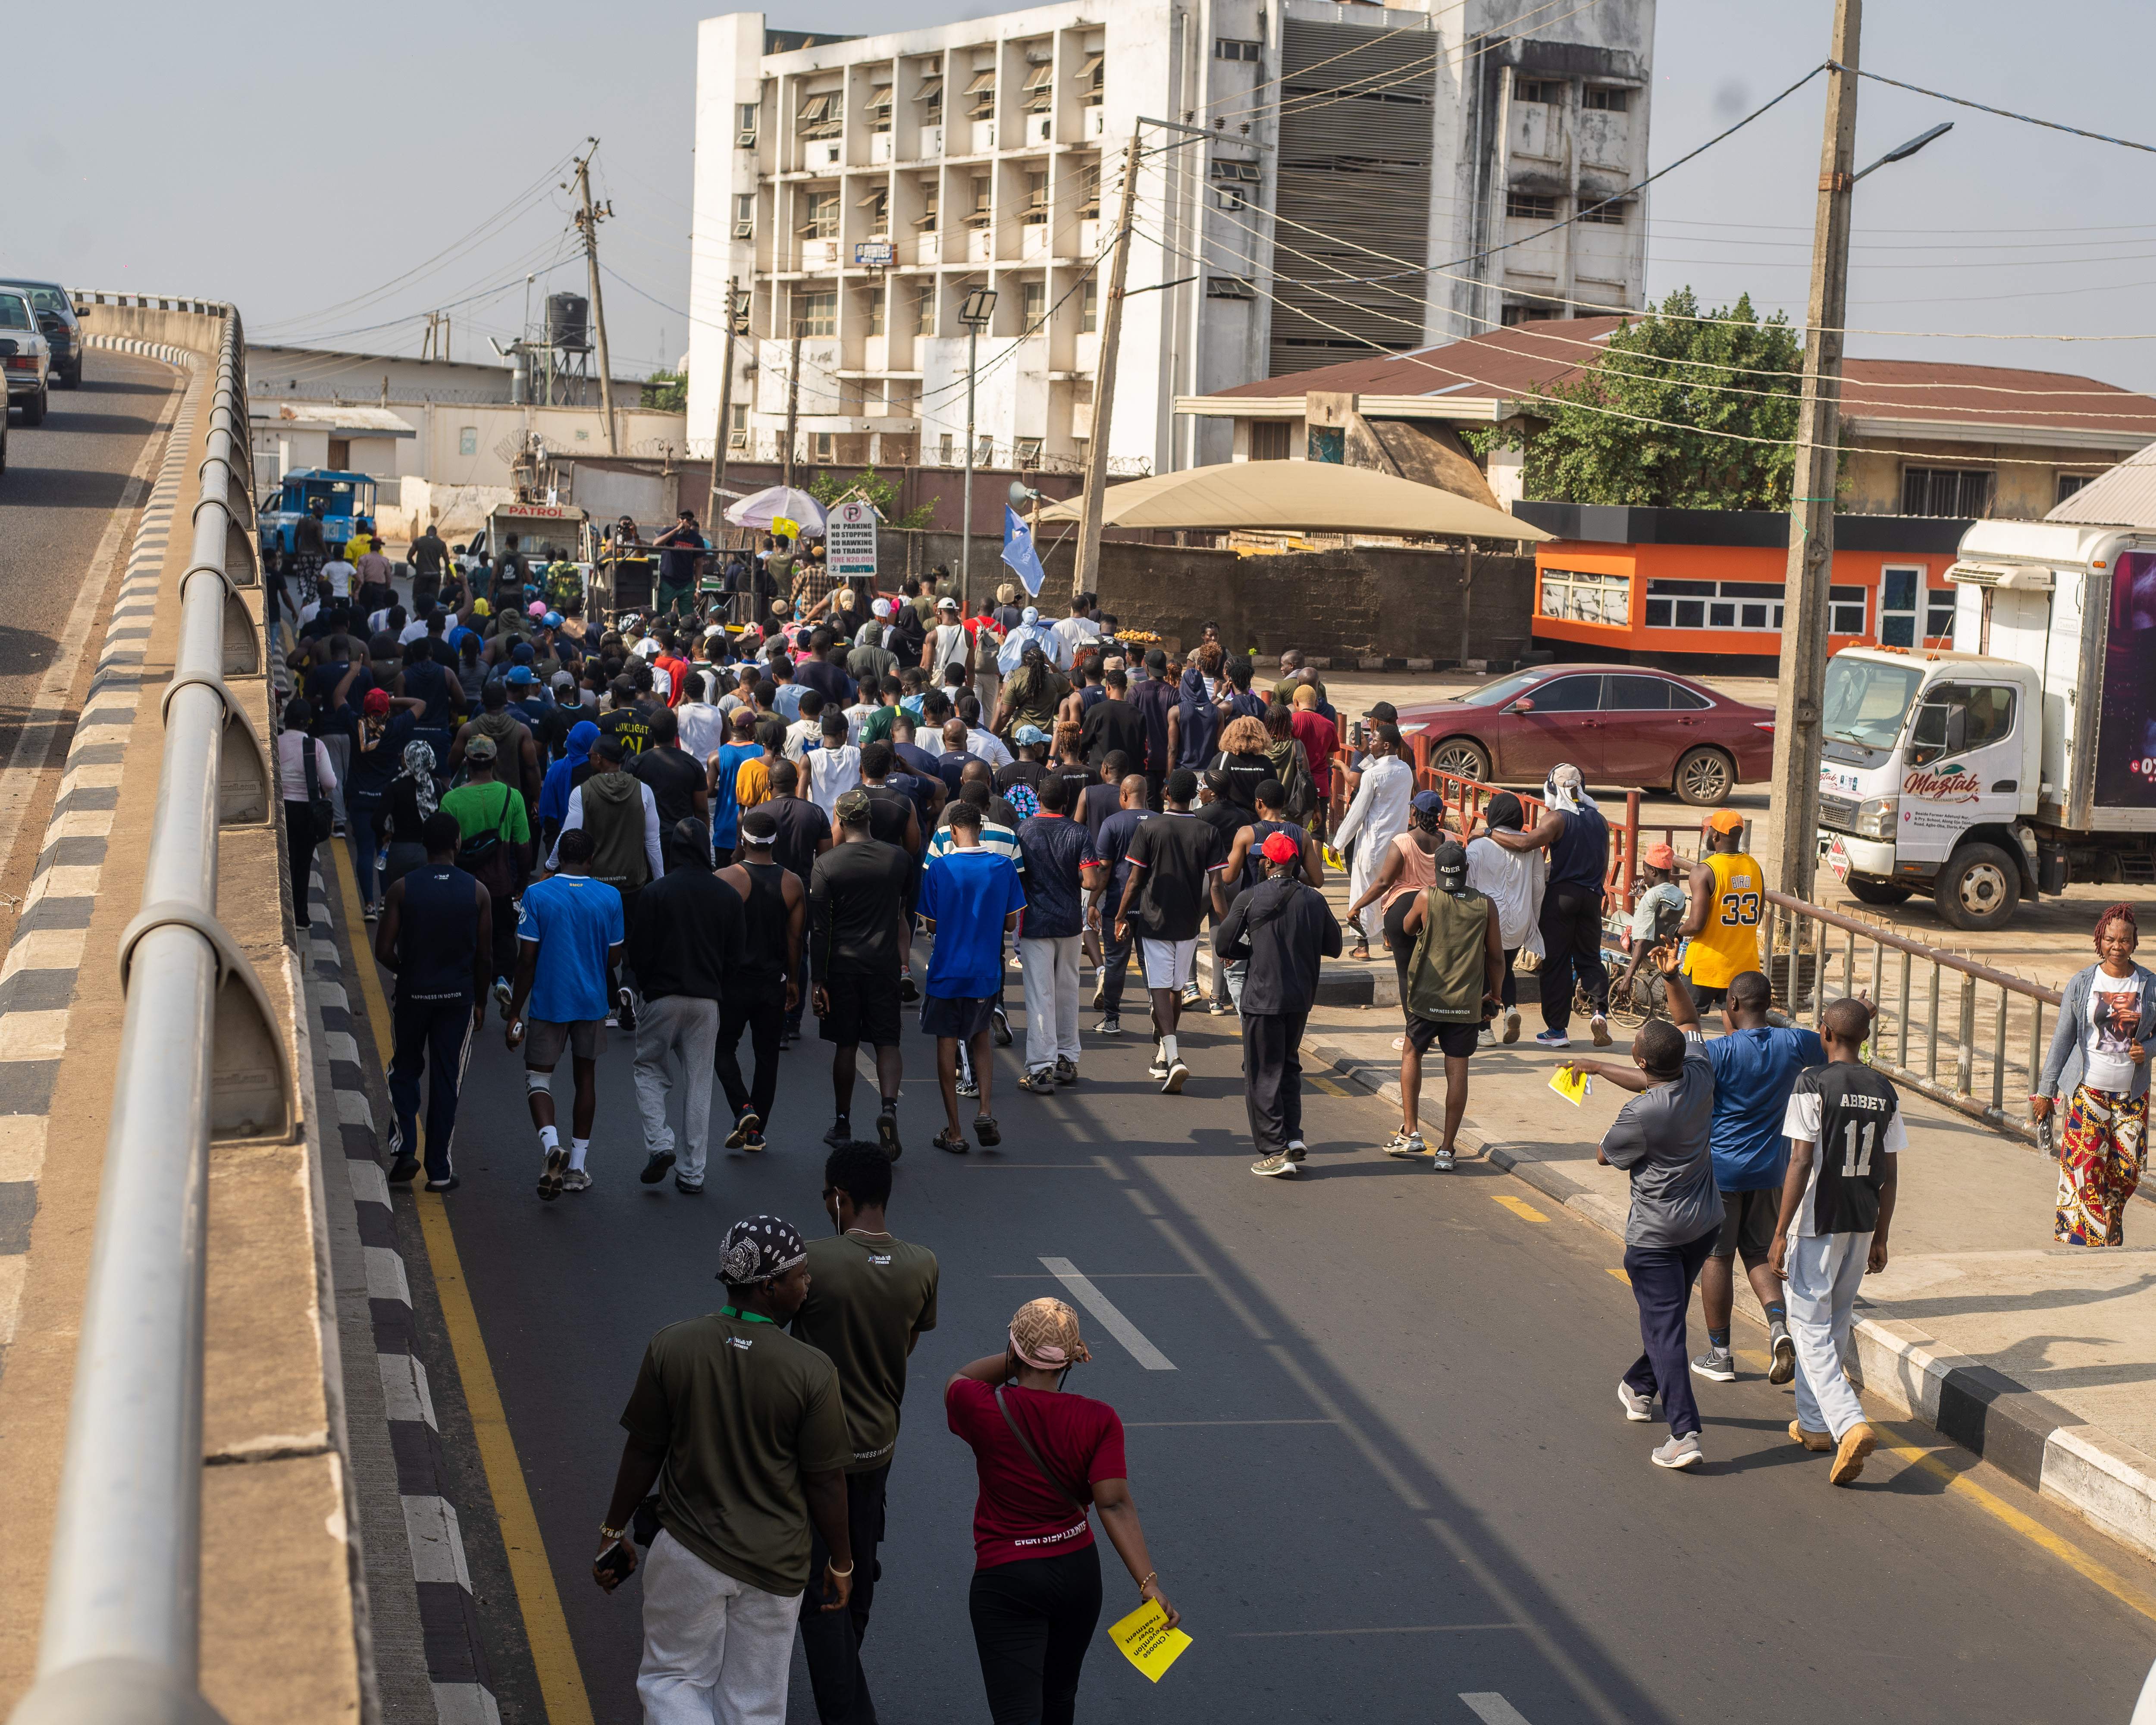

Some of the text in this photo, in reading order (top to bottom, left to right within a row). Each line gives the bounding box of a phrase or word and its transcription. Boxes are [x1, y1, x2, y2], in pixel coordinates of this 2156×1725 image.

[509, 506, 566, 517] PATROL
[2141, 758, 2156, 774] 0
[1731, 875, 1751, 889] BIRD
[1720, 892, 1759, 926] 33
[1840, 1094, 1887, 1111] ABBEY
[1842, 1120, 1875, 1177] 11
[854, 1450, 877, 1459] PPINESS
[1125, 1615, 1161, 1643] Treatment
[1139, 1627, 1154, 1642] Over
[1133, 1626, 1163, 1656] revention
[1143, 1636, 1166, 1658] Choose
